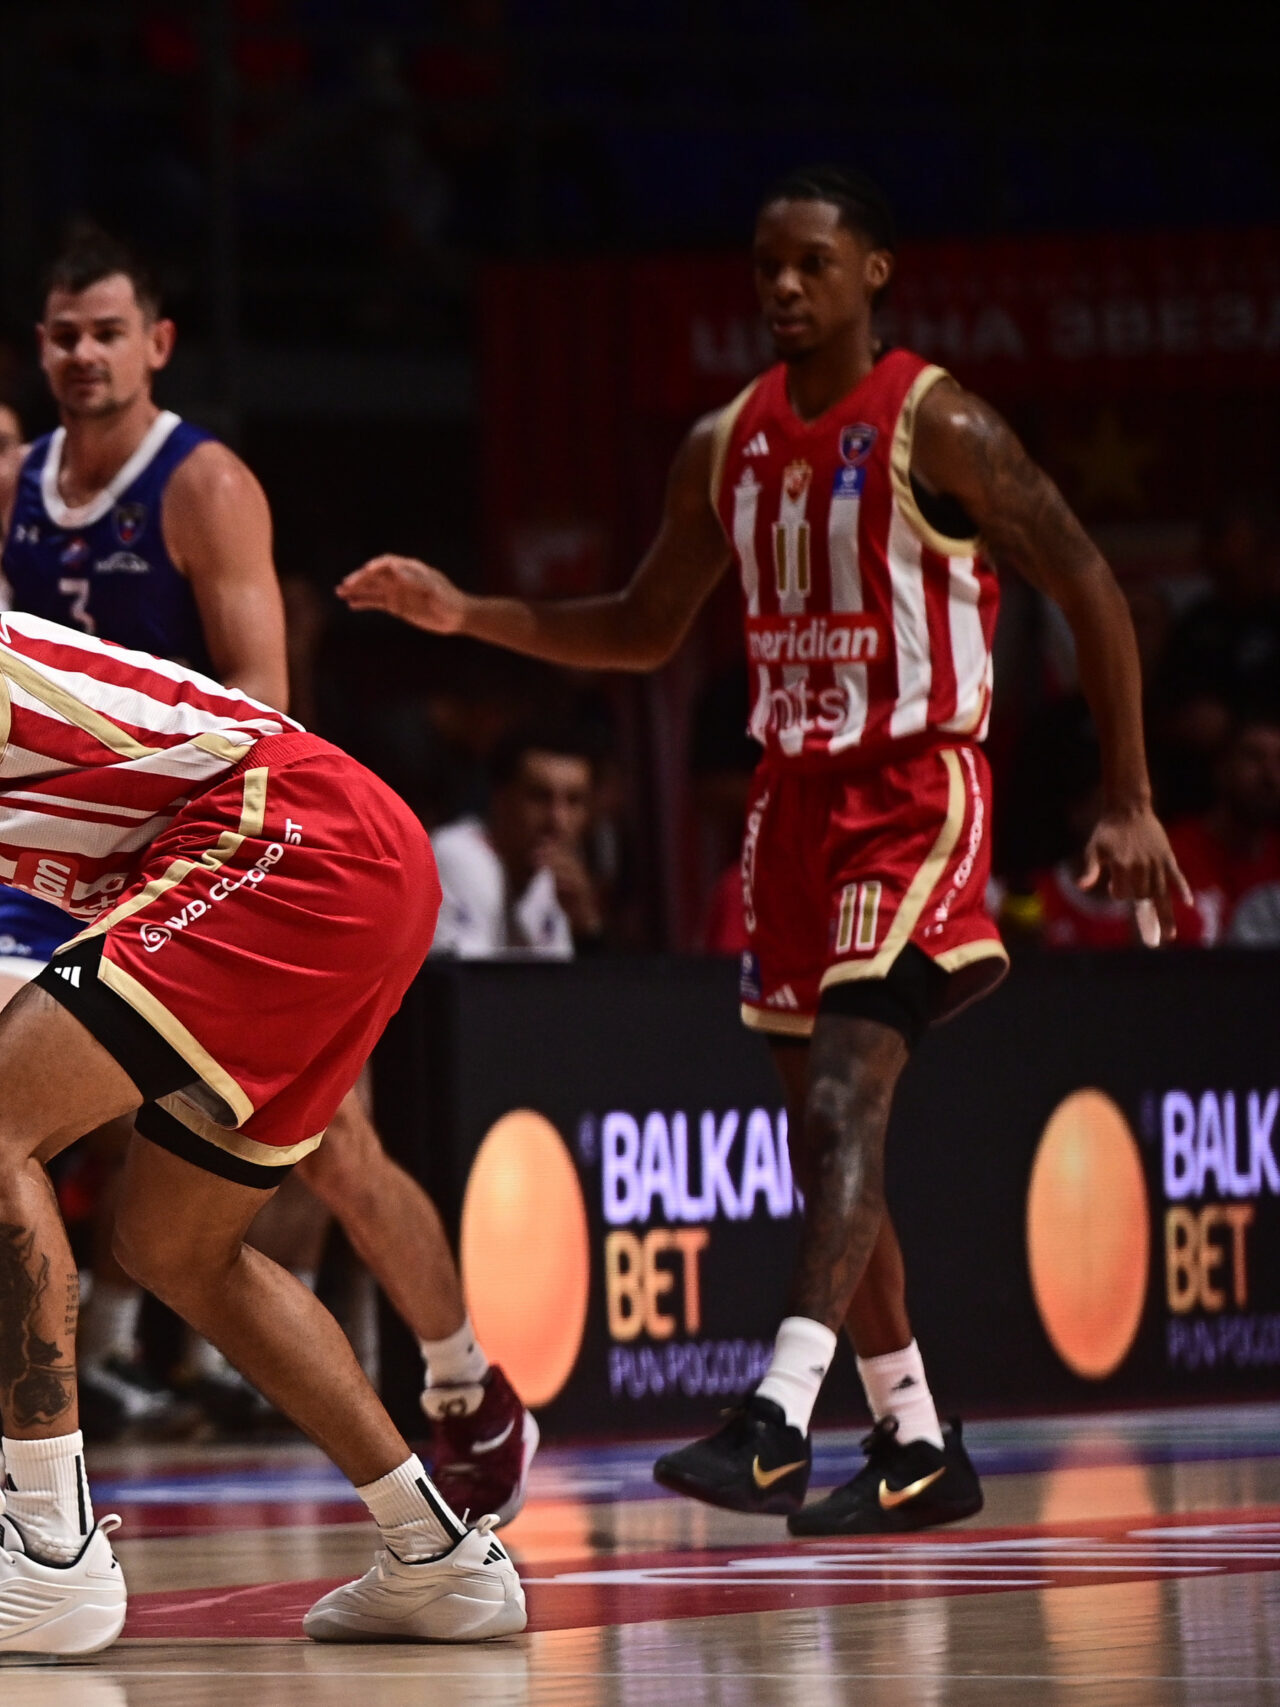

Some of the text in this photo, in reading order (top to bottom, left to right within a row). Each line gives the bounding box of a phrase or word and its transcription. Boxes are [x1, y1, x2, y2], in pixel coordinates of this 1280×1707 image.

[836, 880, 882, 955] 11
[604, 1227, 710, 1342] BET
[1165, 1203, 1256, 1316] BET
